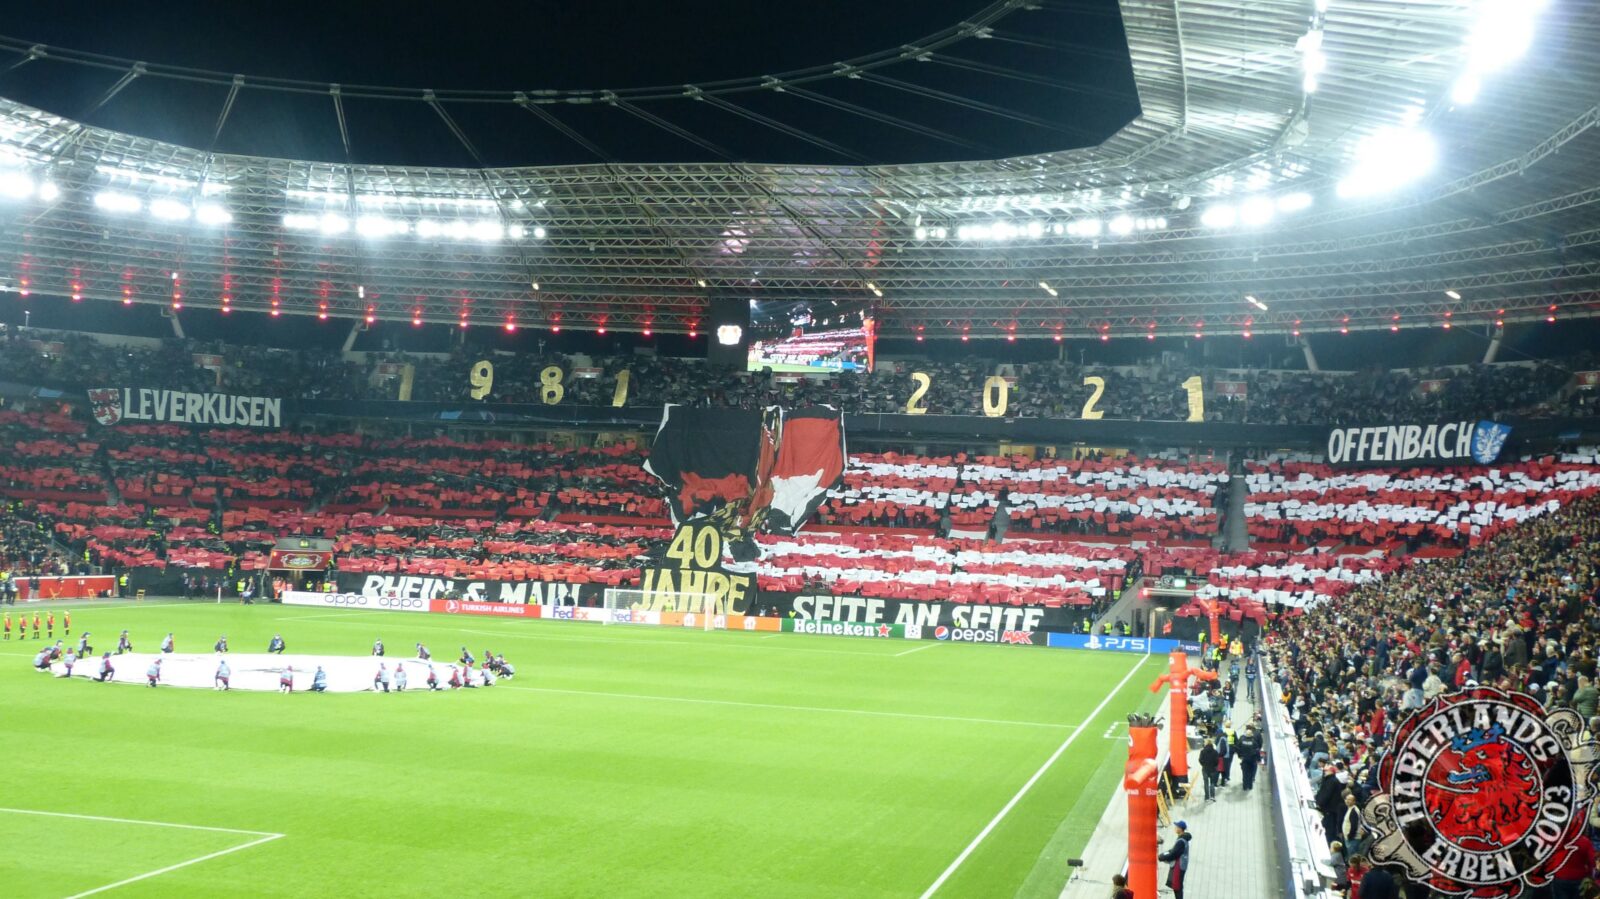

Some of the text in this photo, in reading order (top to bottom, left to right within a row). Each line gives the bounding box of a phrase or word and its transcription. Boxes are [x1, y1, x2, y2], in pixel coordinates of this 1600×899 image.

[123, 387, 282, 428] LEVERKUSEN
[1327, 421, 1476, 464] OFFENBACH
[666, 525, 720, 569] 40
[361, 574, 454, 600] RHEIN
[500, 581, 582, 607] MAIN
[631, 568, 750, 616] JAHRE
[461, 604, 525, 615] TURKISH AIRLINES
[552, 605, 589, 620] FedEx
[611, 608, 648, 623] FedEx
[792, 595, 1045, 632] SEITE AN SEITE
[793, 618, 875, 637] Heineken
[951, 628, 1034, 645] pepsi MAX
[1105, 638, 1145, 650] PS5
